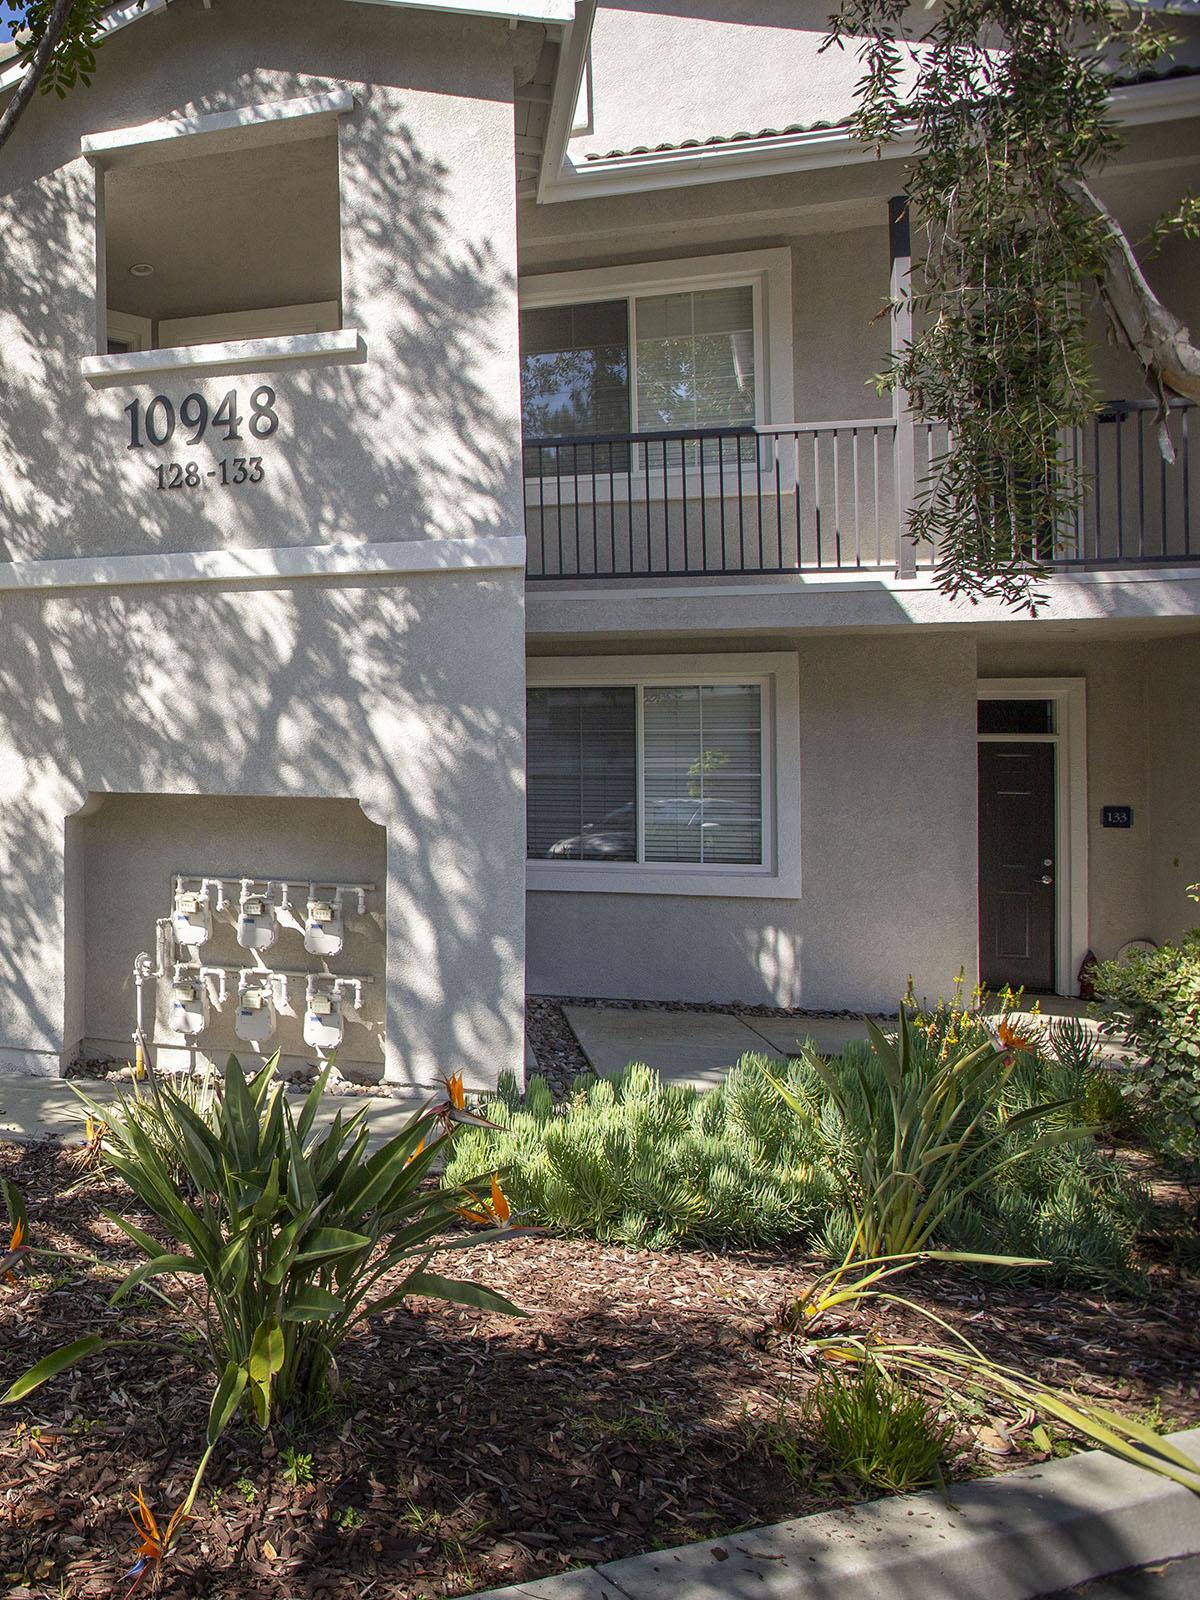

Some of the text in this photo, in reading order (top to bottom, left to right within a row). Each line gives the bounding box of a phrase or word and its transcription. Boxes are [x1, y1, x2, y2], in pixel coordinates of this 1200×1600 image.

[124, 385, 279, 450] 10948
[155, 456, 265, 490] 128-133
[1106, 812, 1128, 823] 133
